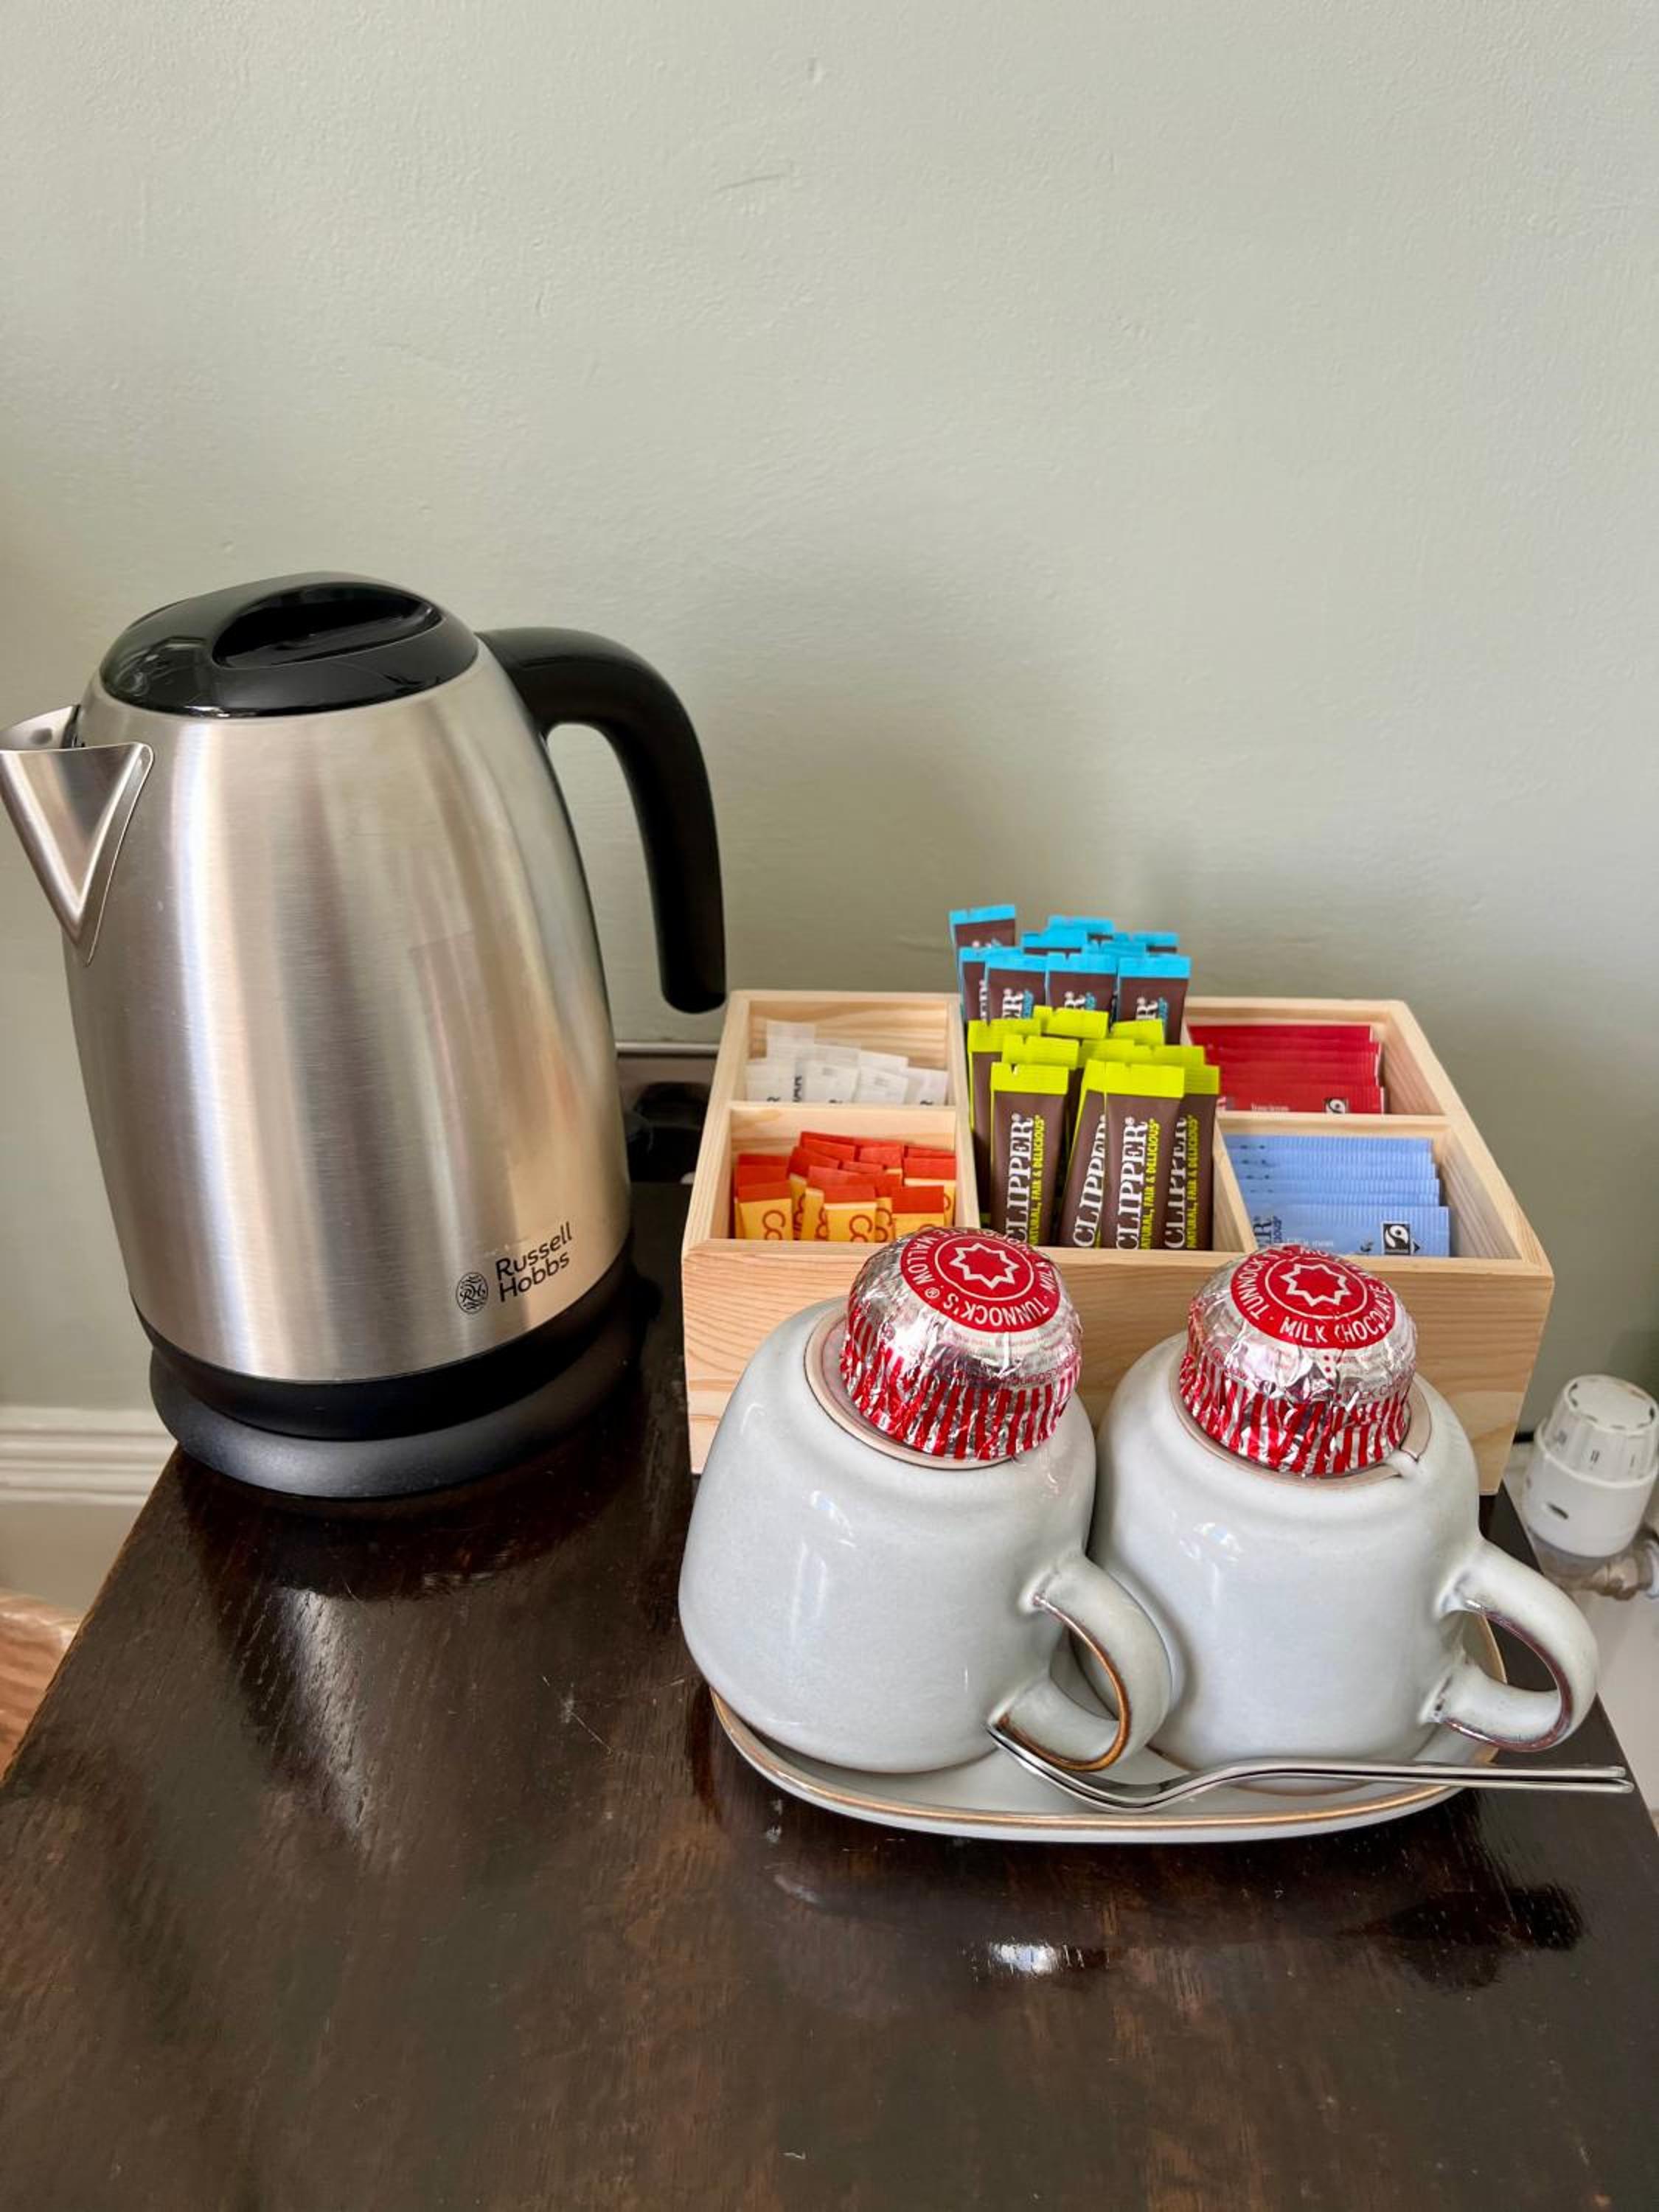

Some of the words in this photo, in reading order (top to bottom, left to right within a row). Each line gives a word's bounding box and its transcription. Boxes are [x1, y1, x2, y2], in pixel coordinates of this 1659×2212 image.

[1032, 1180, 1043, 1200] FAIR
[1116, 1119, 1148, 1250] CLIPPER
[1144, 1186, 1155, 1207] FAIR
[495, 1221, 572, 1281] Russell
[907, 1234, 939, 1286] MALLOW
[499, 1252, 570, 1302] Hobbs
[943, 1293, 1050, 1326] TUNNOCK'S
[1279, 1316, 1329, 1343] MILK
